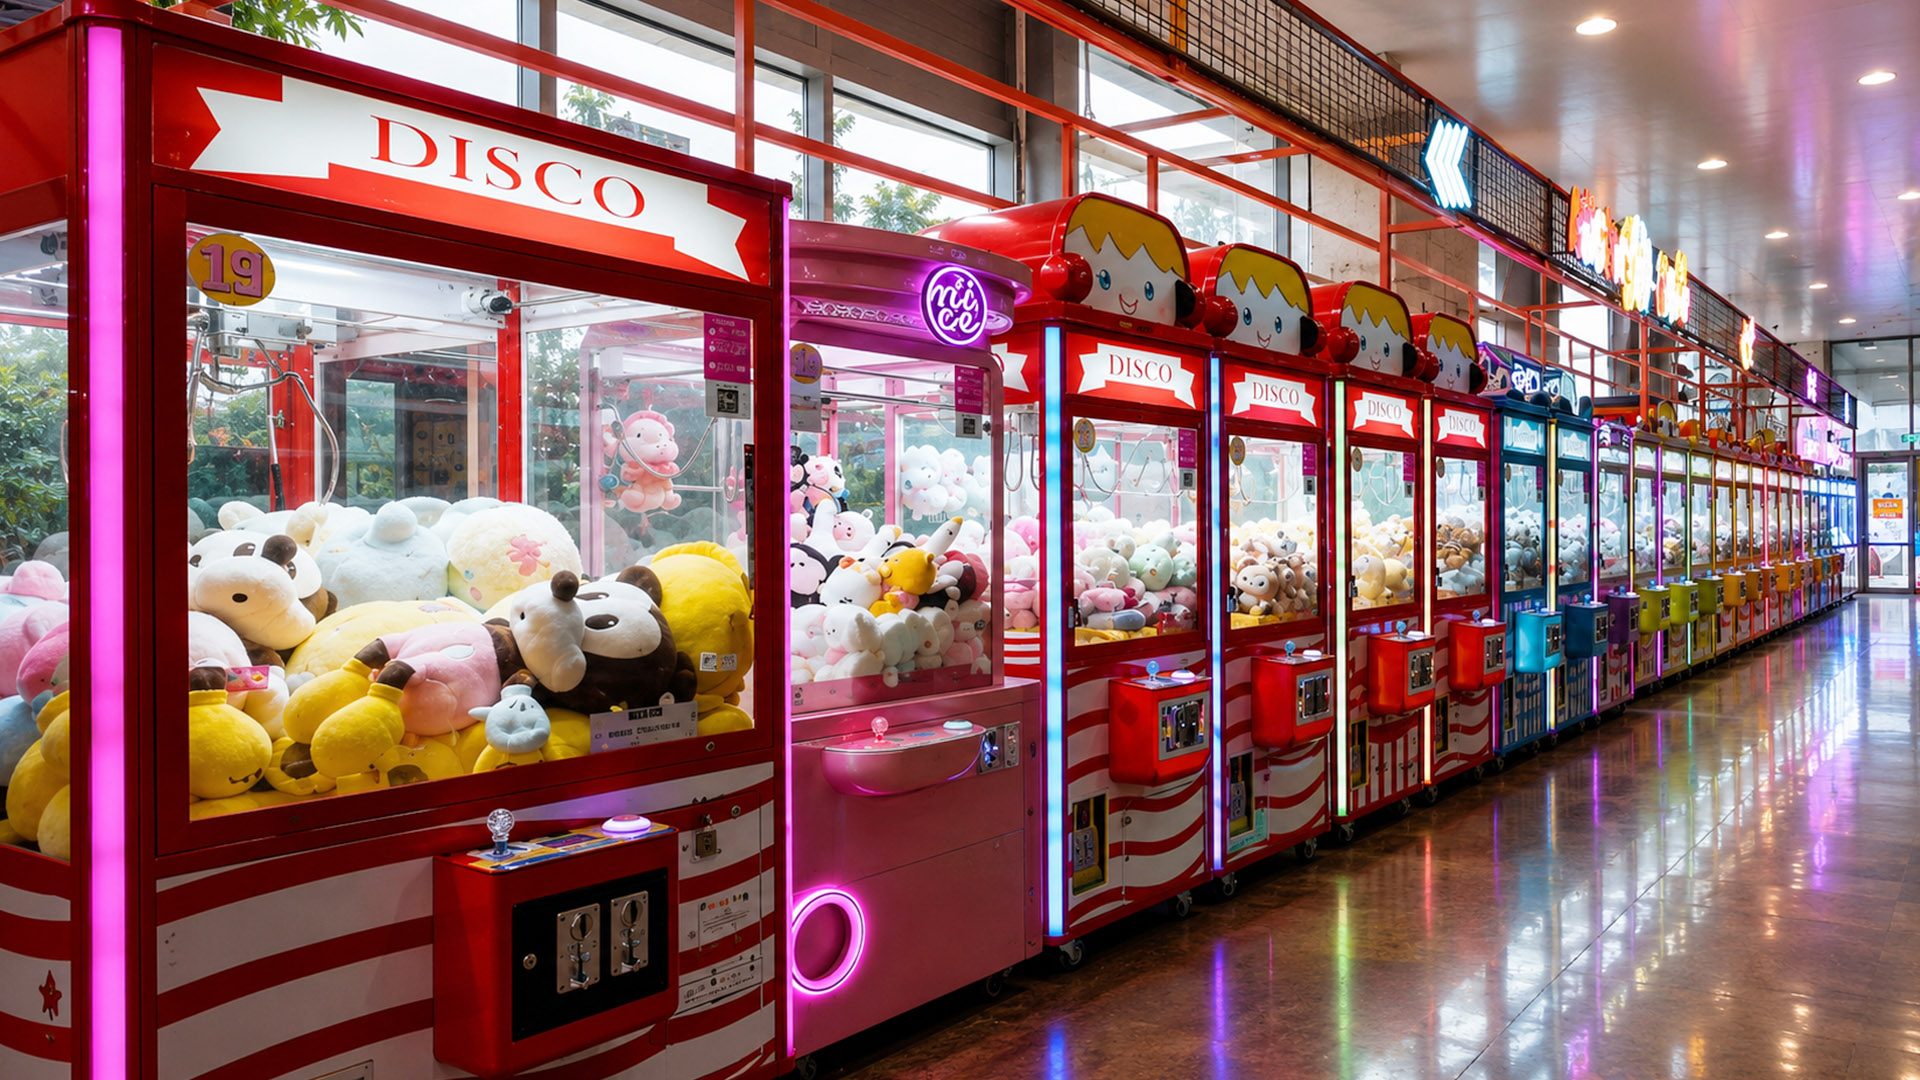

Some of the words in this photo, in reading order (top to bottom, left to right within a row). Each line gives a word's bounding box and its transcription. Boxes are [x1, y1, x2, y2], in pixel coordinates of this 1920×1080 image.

[370, 115, 645, 219] DISCO
[200, 243, 263, 298] 19
[1110, 354, 1173, 384] DISCO
[1253, 381, 1300, 406] DISCO
[1368, 400, 1402, 420] DISCO
[1449, 416, 1476, 433] DISCO
